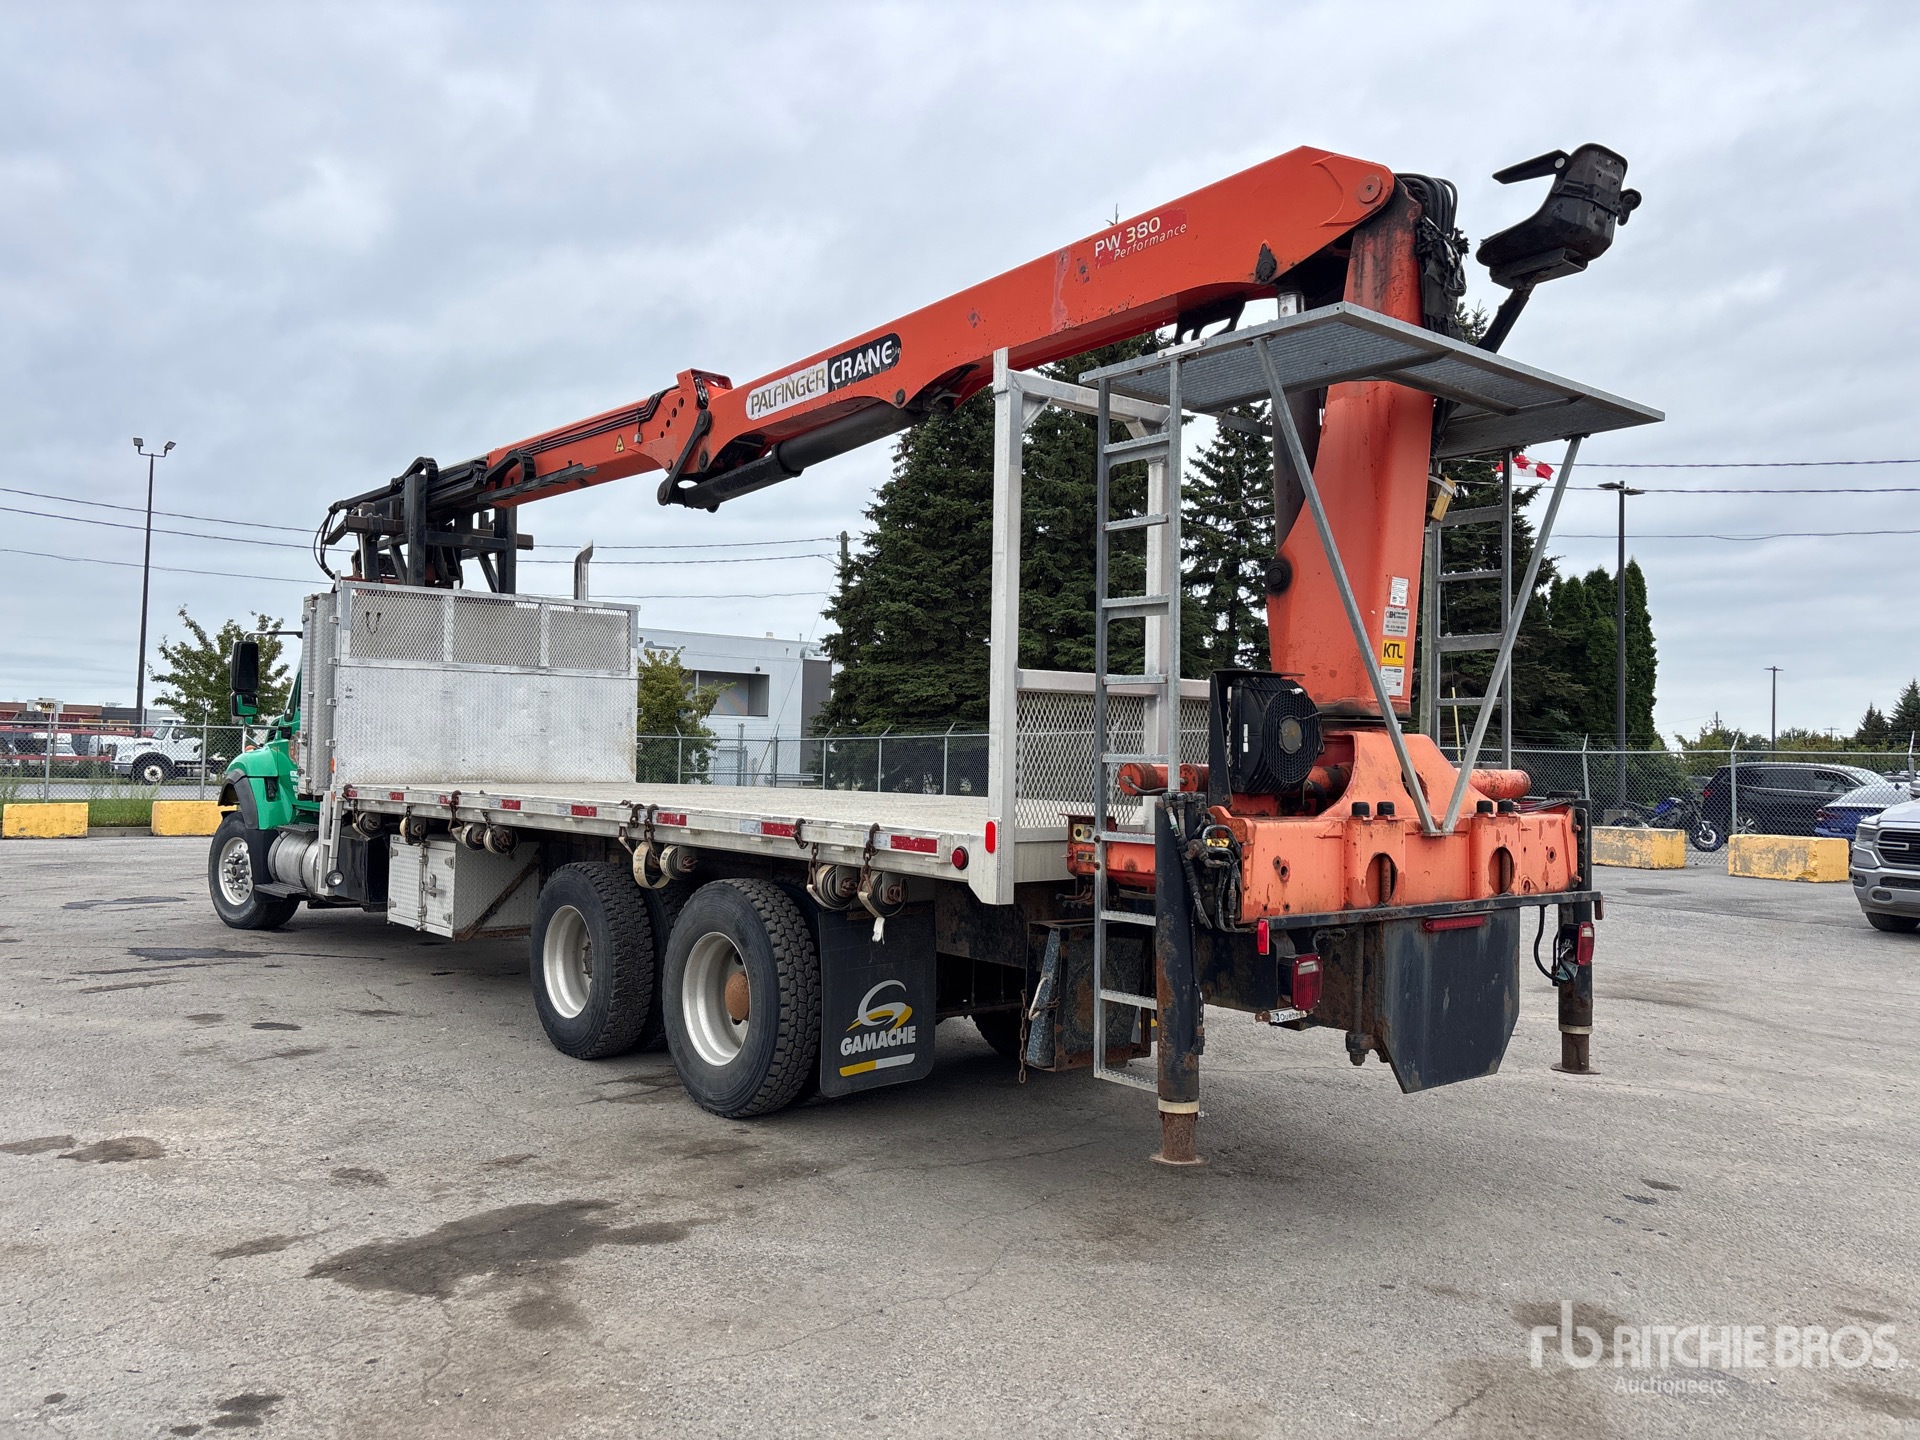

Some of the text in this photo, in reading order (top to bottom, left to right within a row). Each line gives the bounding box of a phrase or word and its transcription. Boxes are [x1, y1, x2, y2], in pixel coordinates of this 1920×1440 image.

[1094, 216, 1161, 257] PW 380
[1113, 223, 1187, 261] Performance
[751, 340, 893, 415] PALFINGER CRANE
[840, 1025, 917, 1056] GAMACHE
